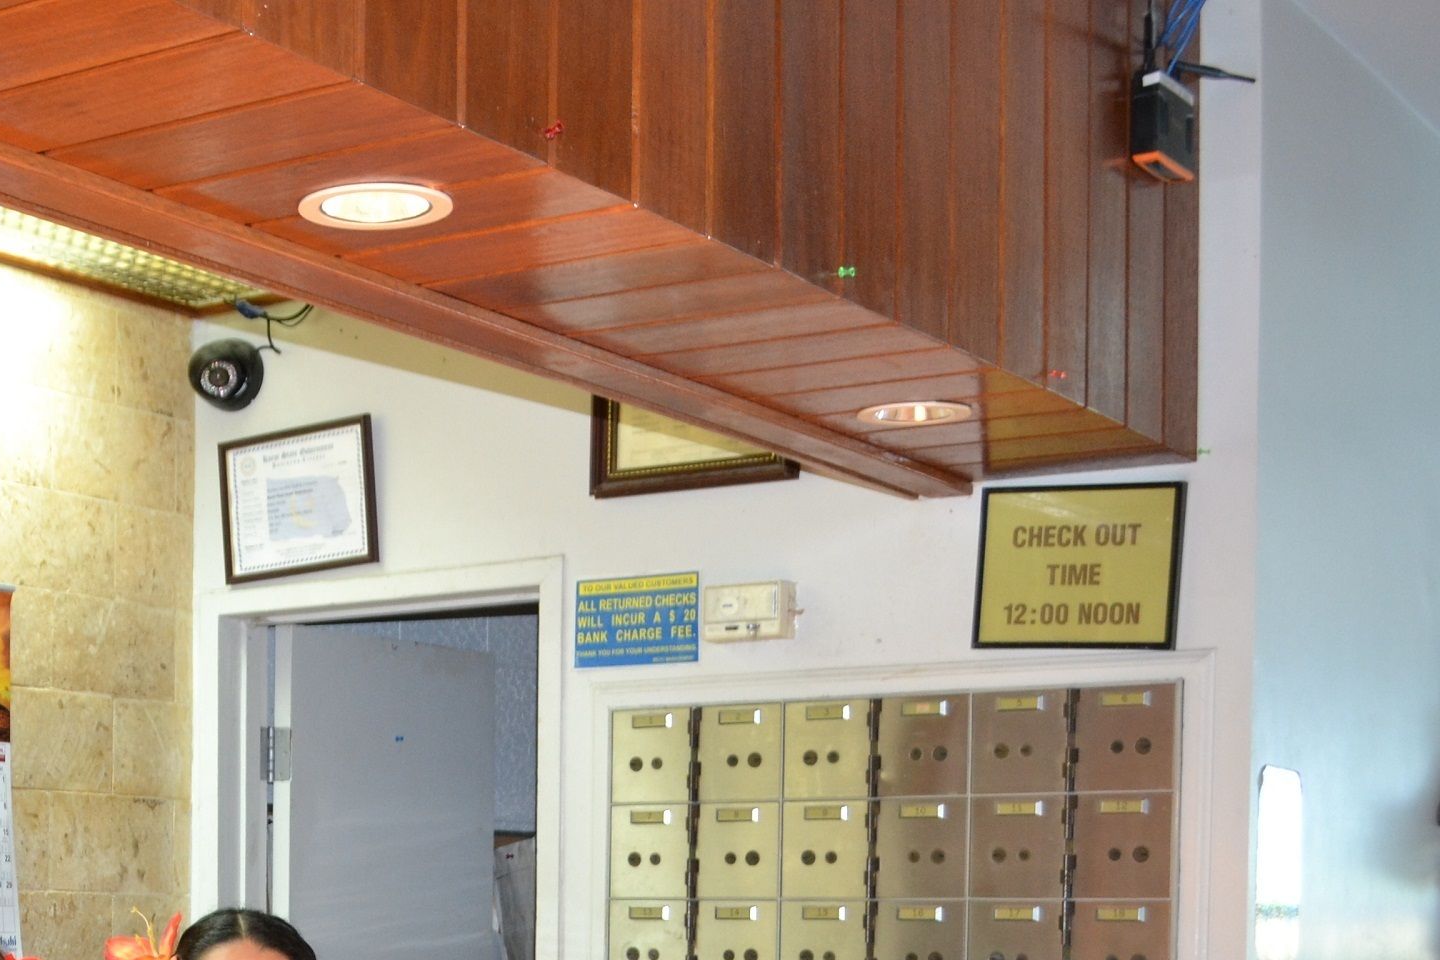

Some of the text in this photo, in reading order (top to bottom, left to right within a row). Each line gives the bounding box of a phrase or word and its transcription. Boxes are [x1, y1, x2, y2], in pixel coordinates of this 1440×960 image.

[1012, 523, 1142, 548] CHECK OUT
[595, 583, 612, 592] OUR
[613, 581, 646, 590] VALUED
[646, 577, 694, 588] CUSTOMERS
[1047, 563, 1101, 586] TIME
[578, 592, 696, 612] ALL RETURNED CHECKS
[578, 609, 696, 628] WILL INCUR A $ 20
[1004, 602, 1141, 625] 12:00 NOON
[577, 625, 696, 644] BANK CHARGE FEE.
